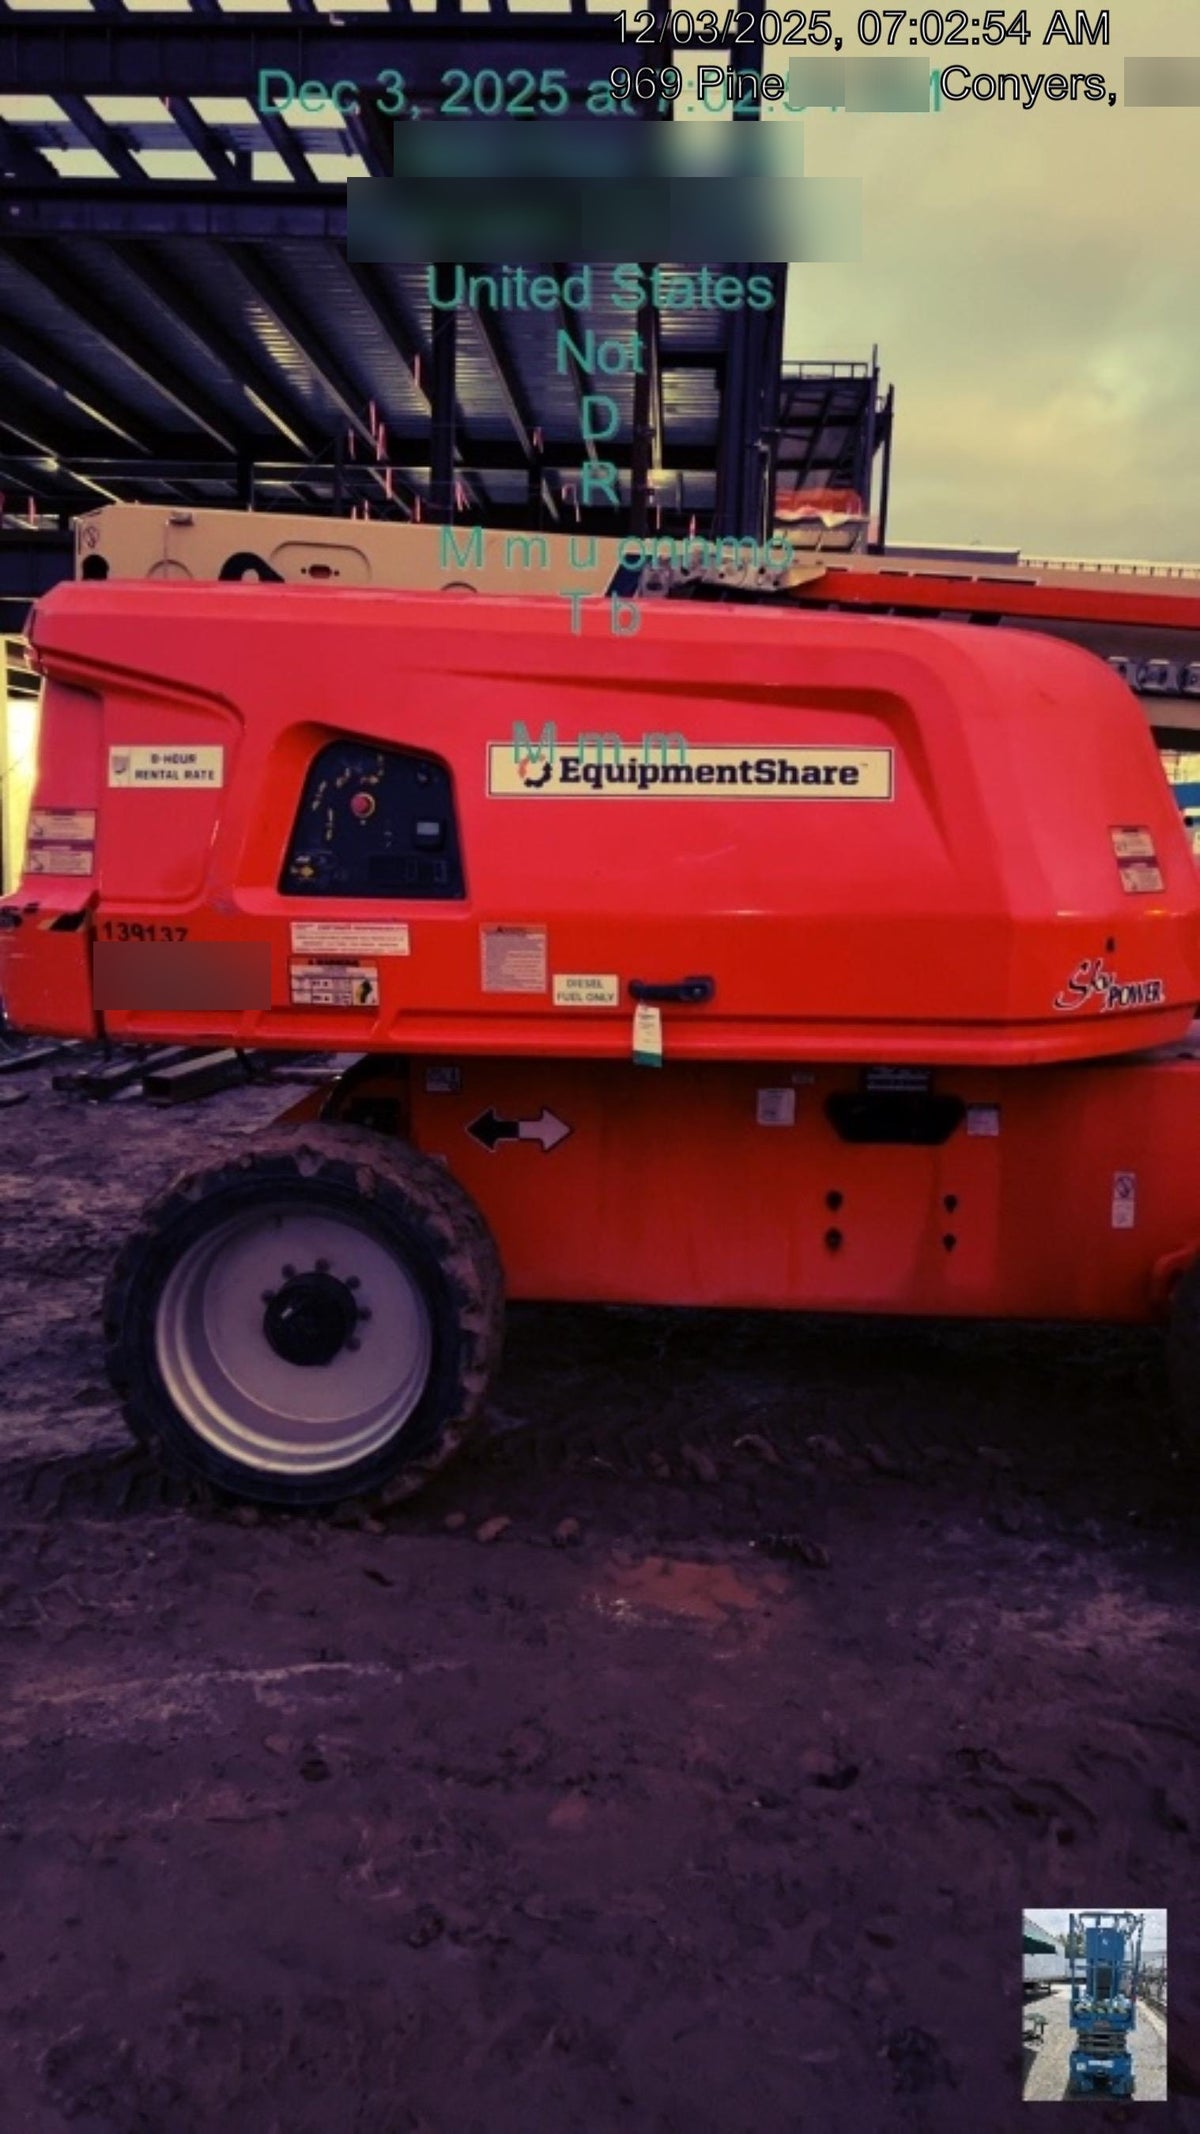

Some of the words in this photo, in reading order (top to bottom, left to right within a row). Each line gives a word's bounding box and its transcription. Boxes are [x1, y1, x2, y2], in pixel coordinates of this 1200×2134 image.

[135, 769, 179, 781] RENTAL
[184, 770, 215, 781] RATE
[558, 756, 860, 789] EquipmentShare
[103, 921, 189, 942] 139137
[566, 978, 603, 990] DIESEL
[557, 993, 582, 1003] FUEL
[585, 992, 614, 1003] ONLY
